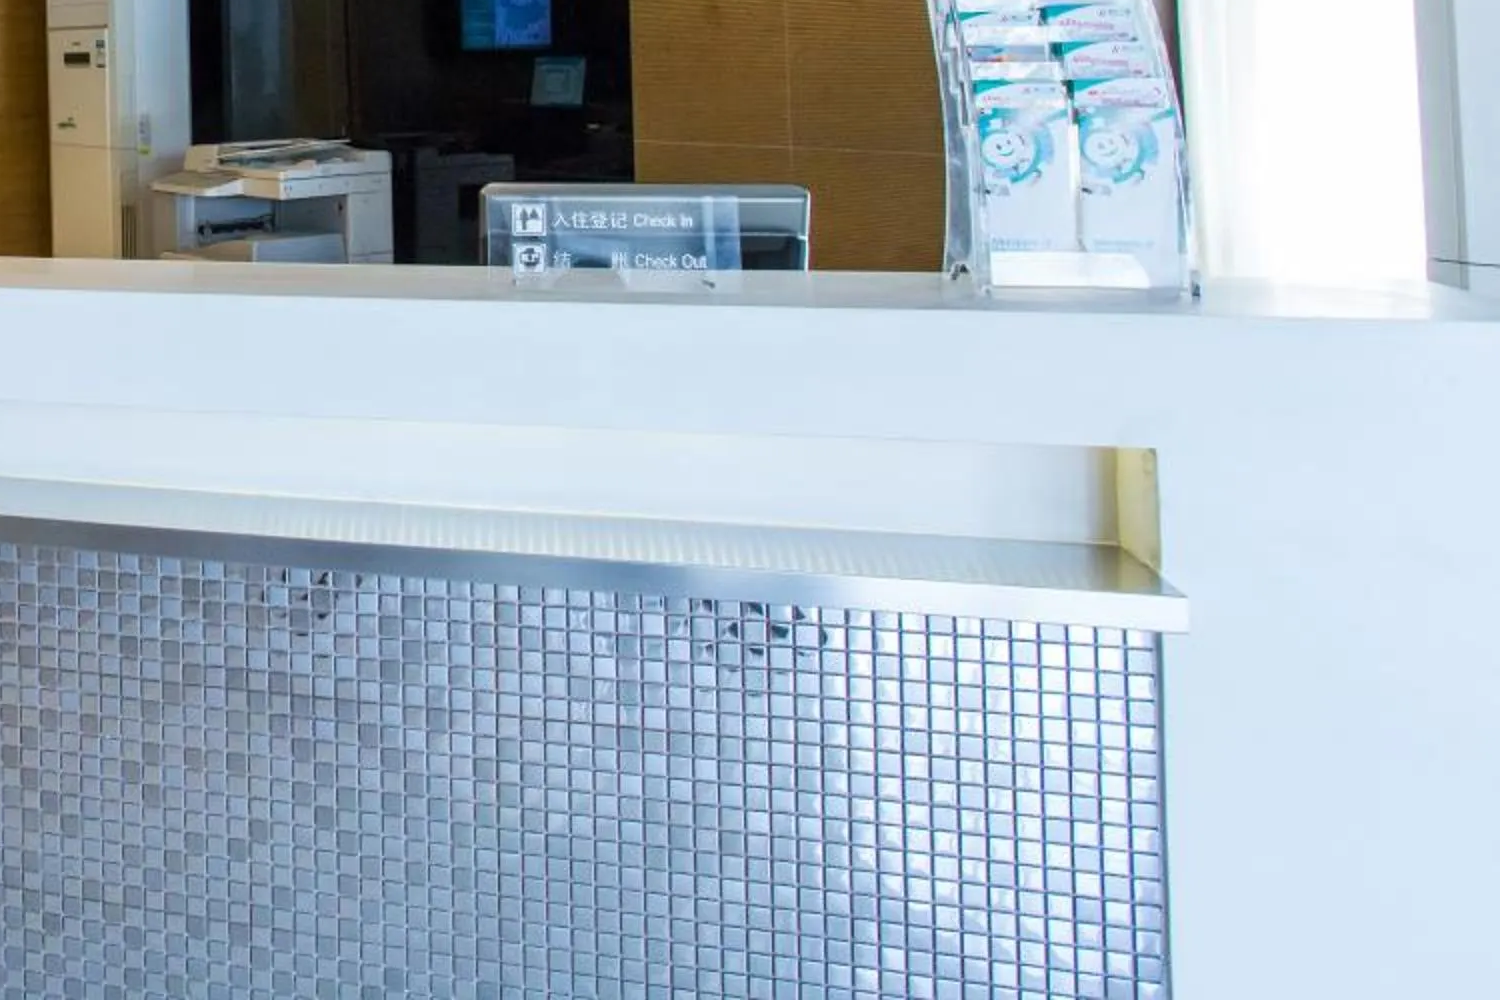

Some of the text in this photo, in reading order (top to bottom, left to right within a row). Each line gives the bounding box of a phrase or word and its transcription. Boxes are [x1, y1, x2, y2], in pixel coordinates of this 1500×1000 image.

[553, 211, 628, 229] 入住登记
[633, 213, 677, 228] Check
[634, 253, 677, 269] Check
[681, 253, 708, 269] Out
